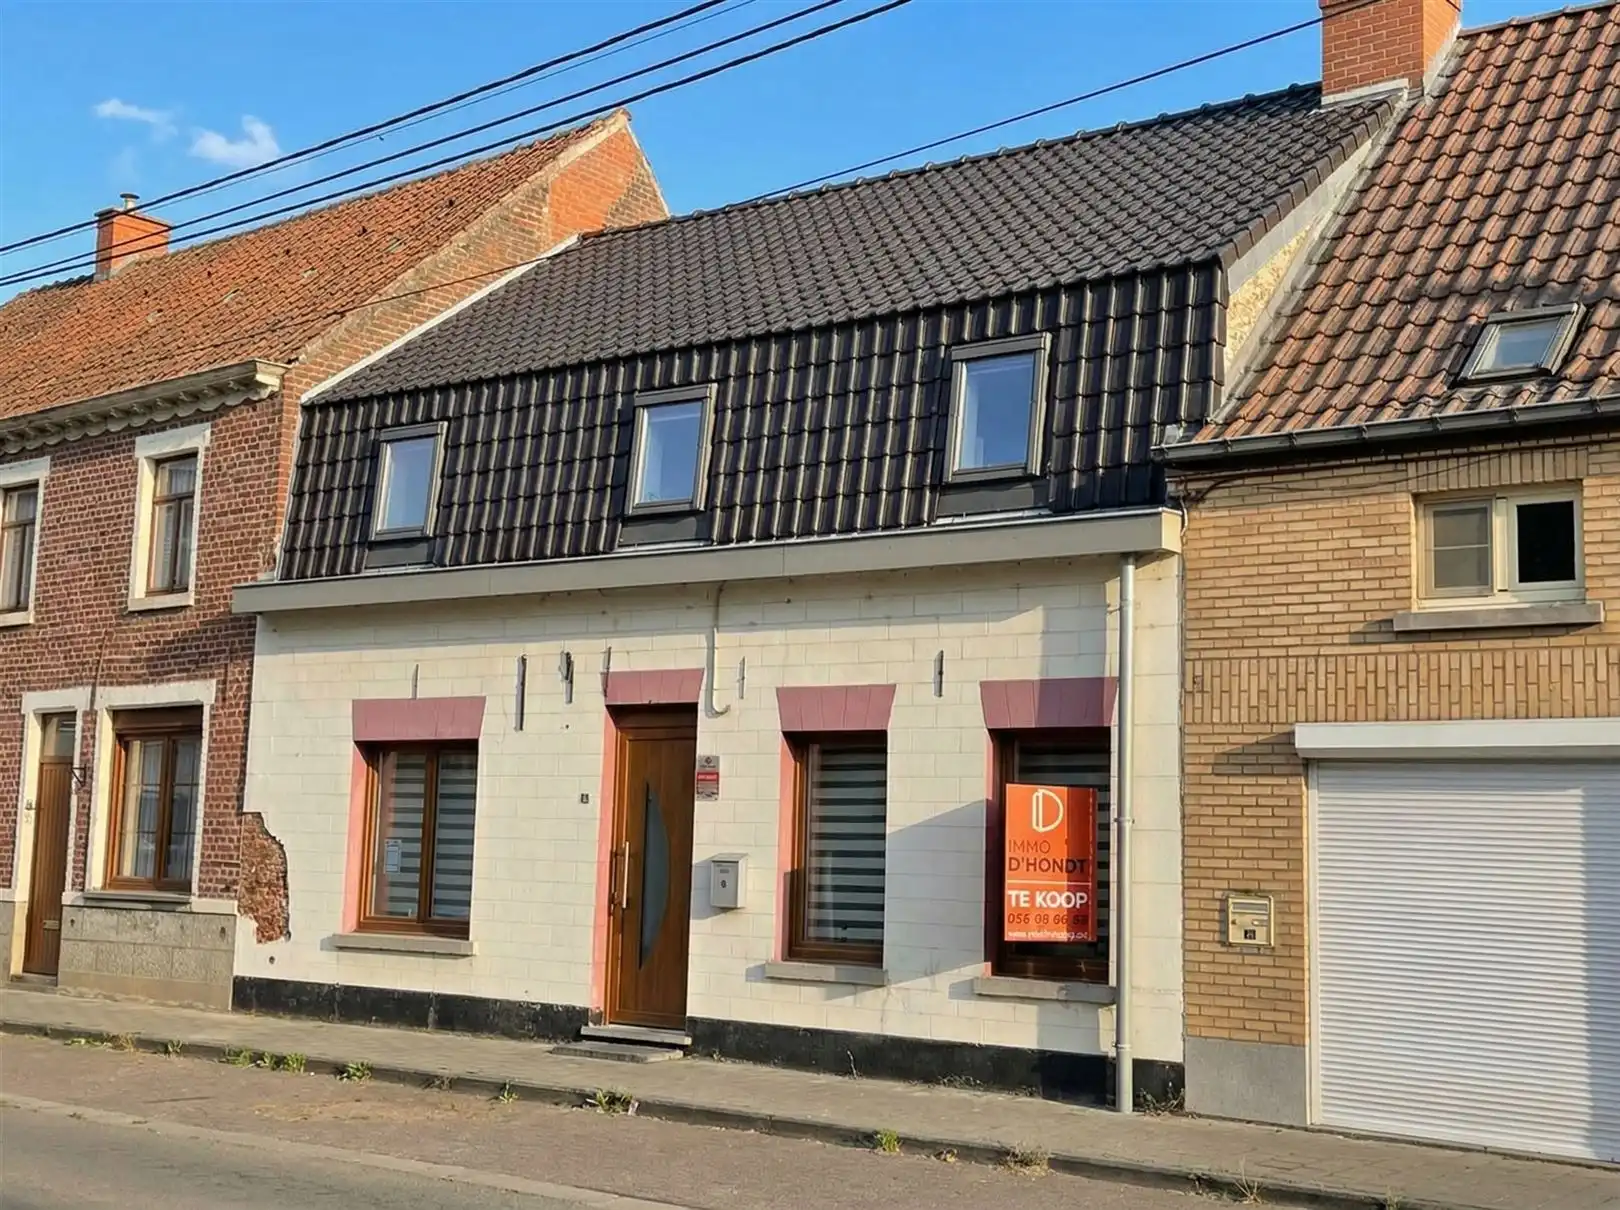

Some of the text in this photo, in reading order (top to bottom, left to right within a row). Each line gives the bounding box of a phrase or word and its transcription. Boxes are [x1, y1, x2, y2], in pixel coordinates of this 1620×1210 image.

[1008, 839, 1051, 854] IMMO
[1008, 856, 1087, 874] D'HONDT
[1008, 890, 1088, 909] TE KOOP
[1008, 912, 1030, 925] 056
